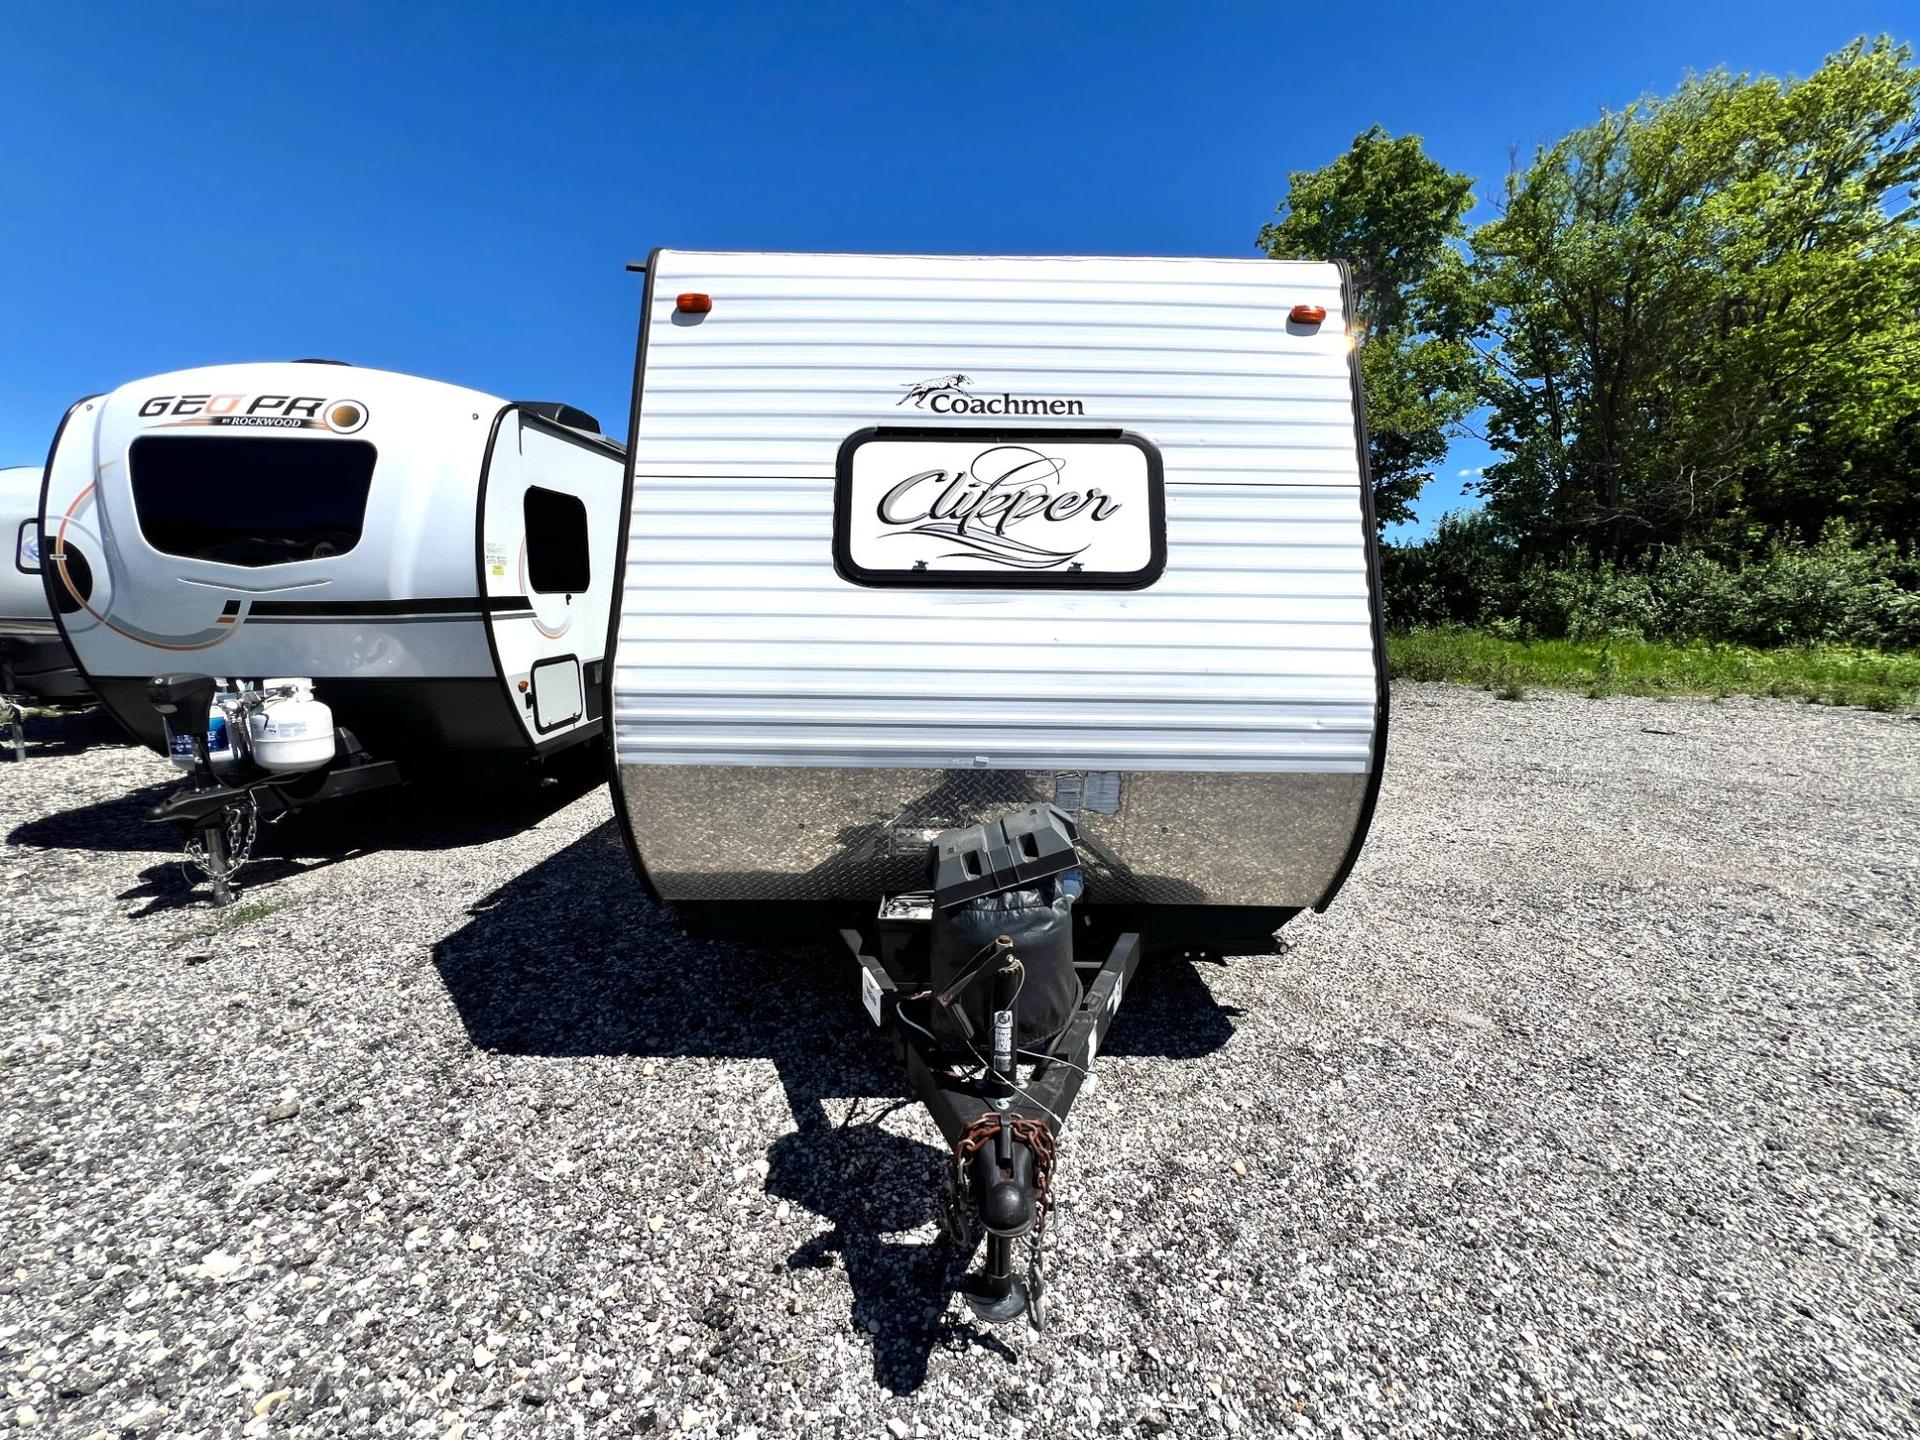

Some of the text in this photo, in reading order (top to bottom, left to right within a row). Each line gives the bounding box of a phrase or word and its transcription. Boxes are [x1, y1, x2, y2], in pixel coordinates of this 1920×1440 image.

[138, 394, 247, 417] GEO
[931, 393, 1084, 415] Coachmen
[232, 417, 302, 427] ROCKWOOD
[877, 446, 1122, 536] Clipper
